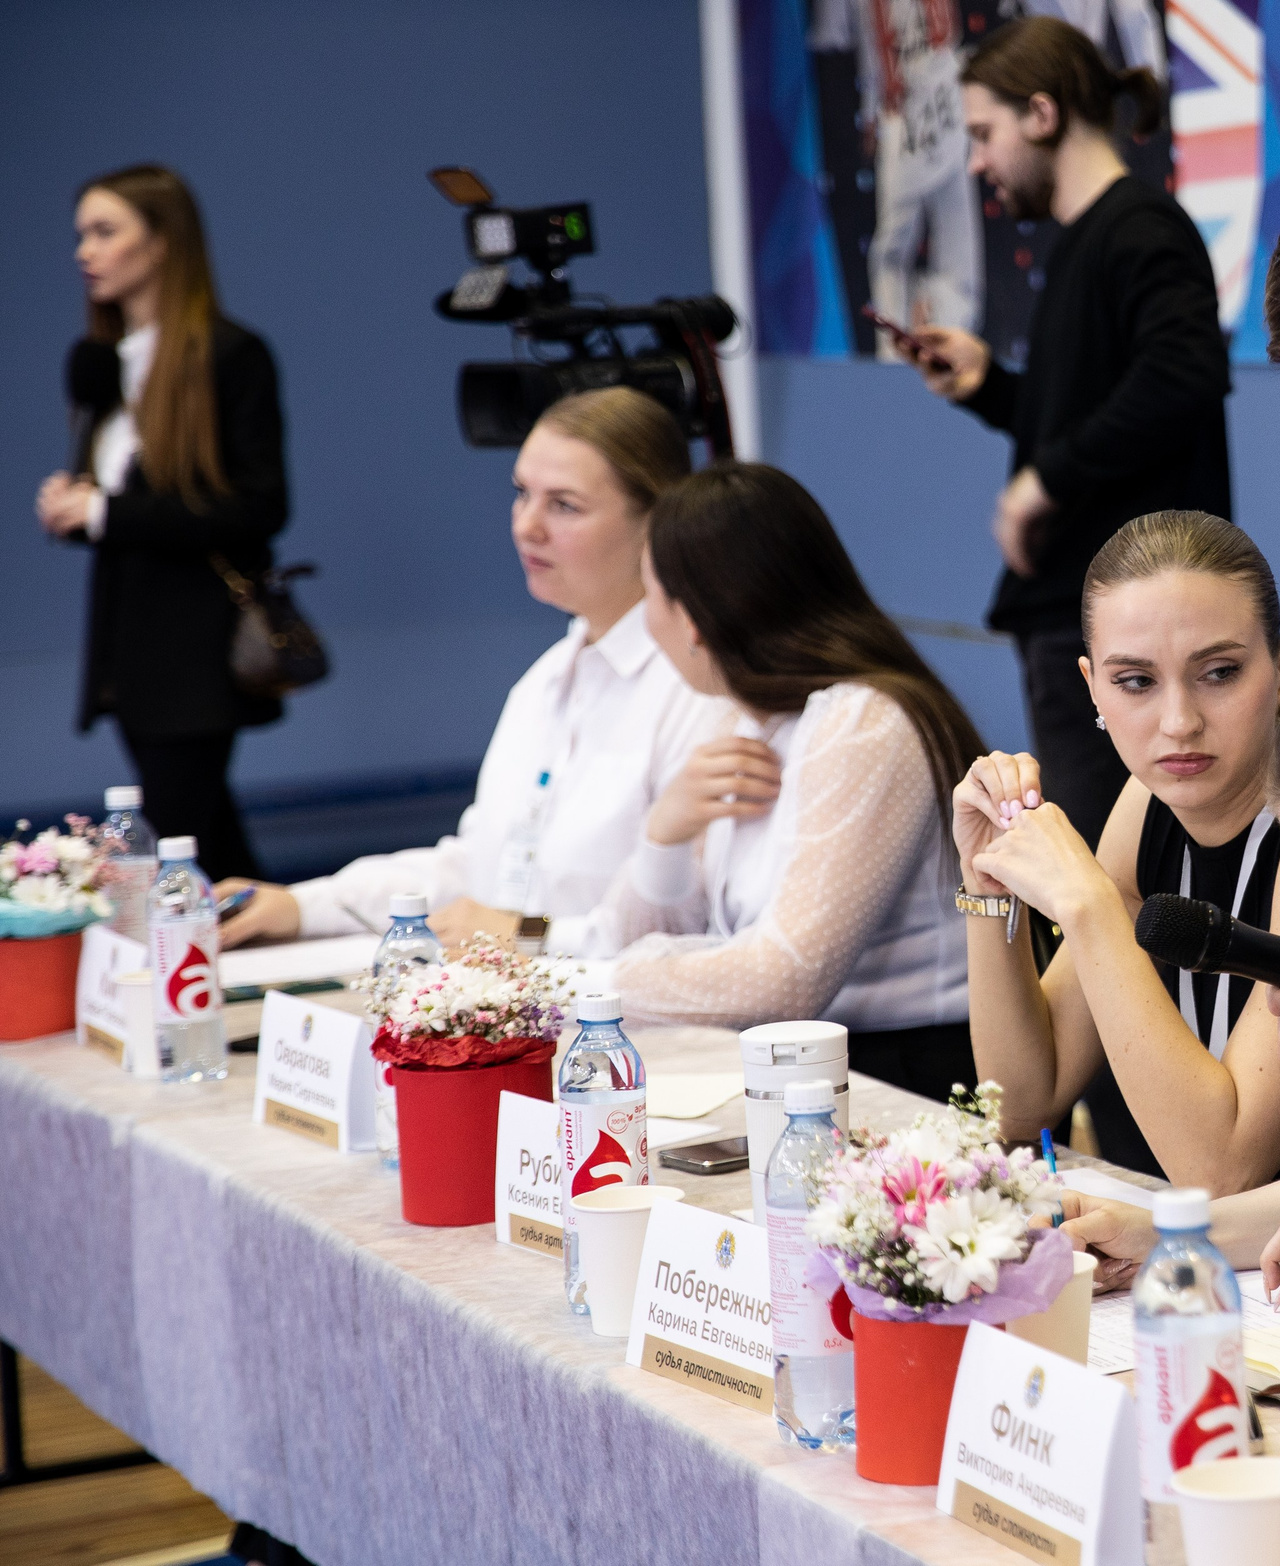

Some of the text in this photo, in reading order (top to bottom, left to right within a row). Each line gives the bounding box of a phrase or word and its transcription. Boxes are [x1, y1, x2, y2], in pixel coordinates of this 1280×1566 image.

[564, 1110, 576, 1171] ариант
[508, 1183, 549, 1212] Ксения
[519, 1226, 543, 1243] судья
[654, 1260, 773, 1326] Побережню
[648, 1301, 697, 1337] Карина
[701, 1319, 773, 1363] Евгеньевн
[655, 1350, 763, 1400] судья артистичности
[990, 1400, 1056, 1467] ФИНК
[957, 1441, 1086, 1525] Виктория Андреевна
[972, 1501, 1057, 1558] судья сложности
